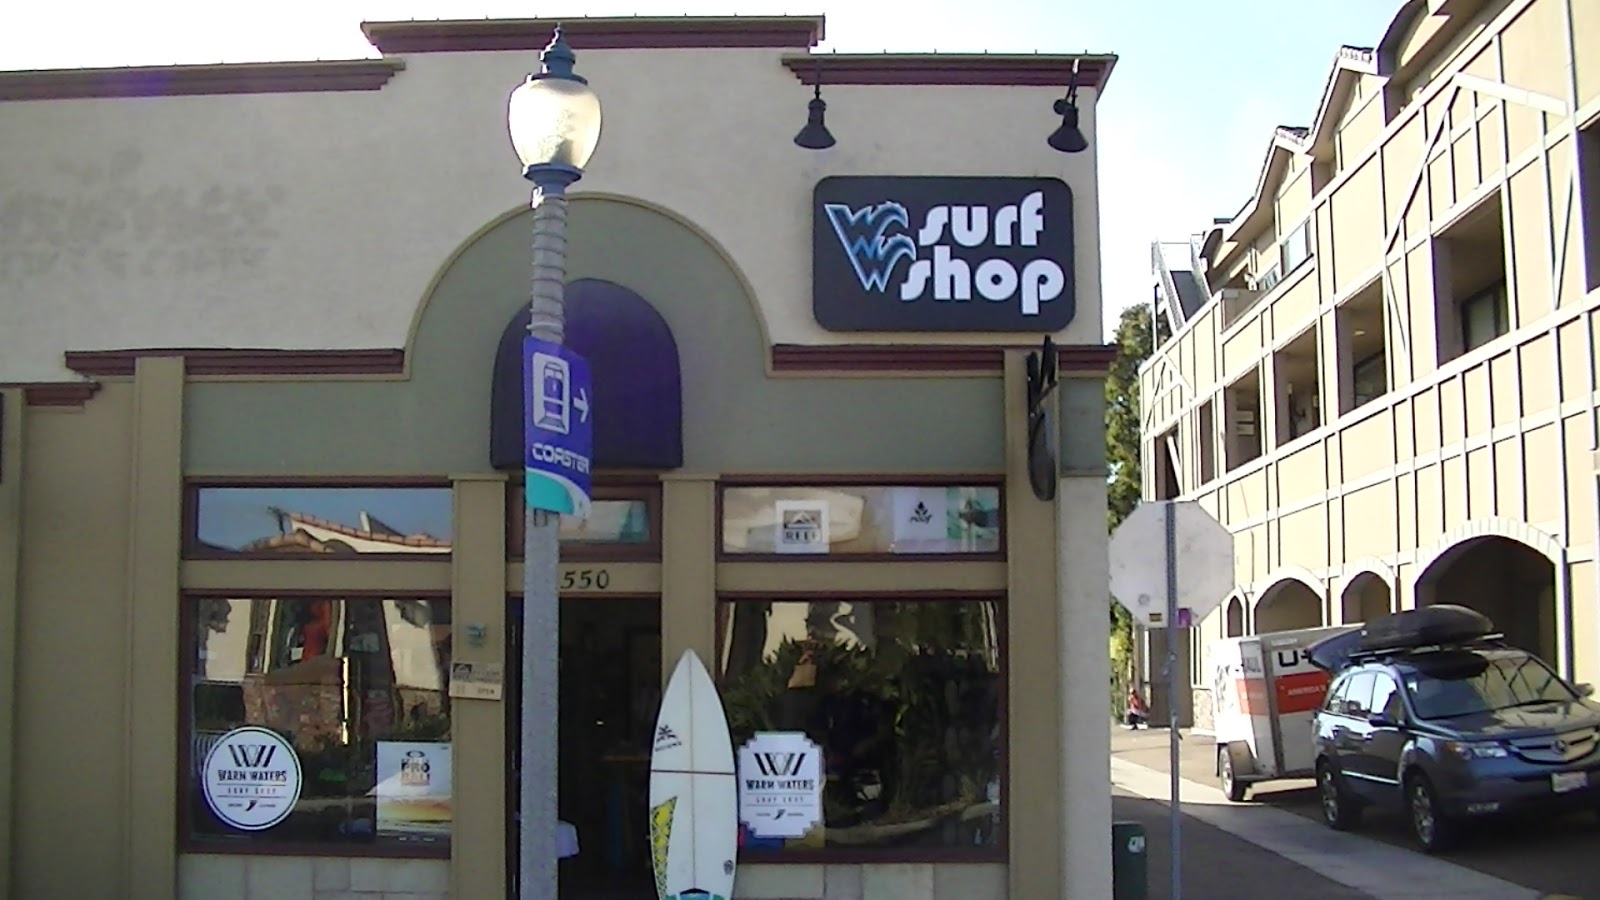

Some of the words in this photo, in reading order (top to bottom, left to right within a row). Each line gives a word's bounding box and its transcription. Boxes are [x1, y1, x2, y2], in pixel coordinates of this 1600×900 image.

[919, 191, 1044, 247] surf
[901, 245, 1065, 315] shop
[532, 441, 590, 474] COASTER
[560, 569, 610, 589] 550
[217, 769, 246, 781] WARM
[249, 770, 287, 782] WATERS
[745, 779, 775, 790] WARM
[777, 779, 814, 791] WATERS
